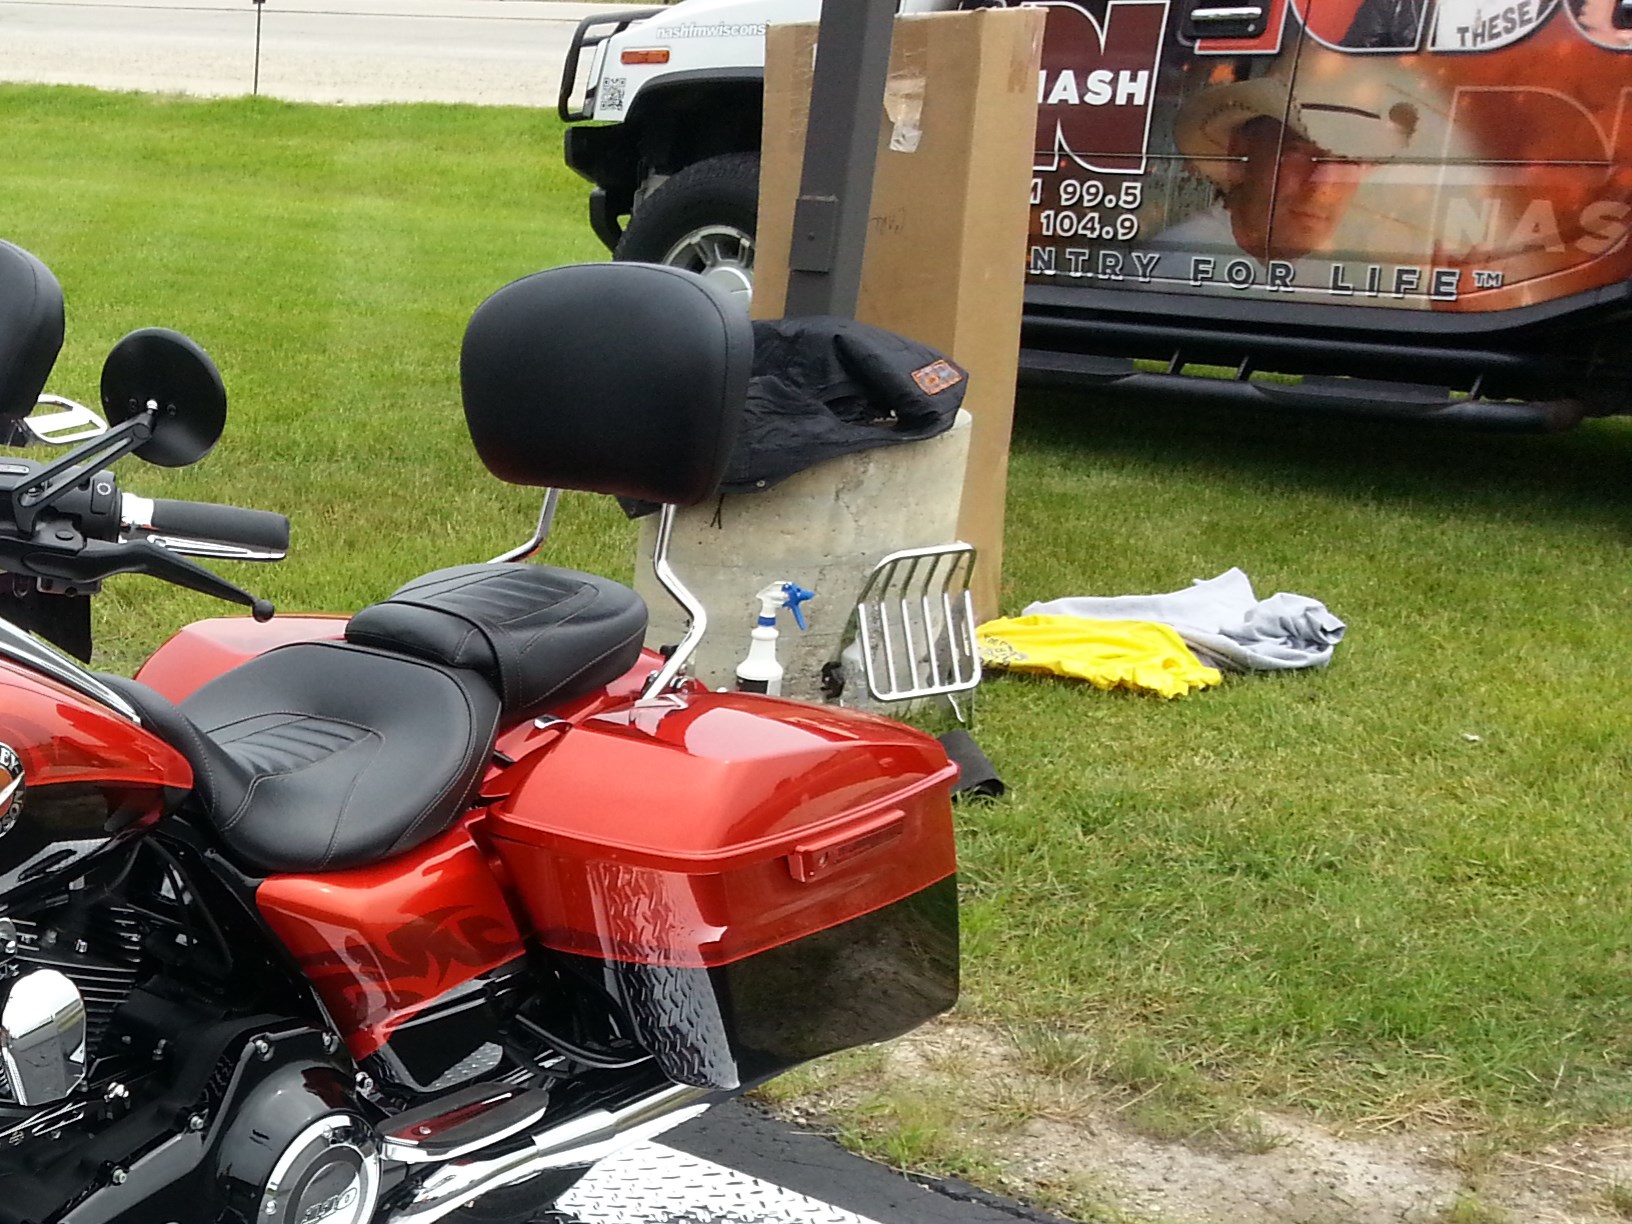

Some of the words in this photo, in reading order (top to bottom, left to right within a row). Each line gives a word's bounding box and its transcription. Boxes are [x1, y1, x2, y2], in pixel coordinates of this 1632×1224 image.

[656, 22, 766, 39] nashfmwiscons
[1456, 1, 1534, 48] THESE
[1059, 179, 1142, 209] 99.5
[1040, 210, 1139, 240] 104.9
[1442, 199, 1631, 257] NAS
[1030, 246, 1160, 282] NTRY
[1190, 256, 1295, 292] FOR
[1329, 264, 1460, 300] LIFE
